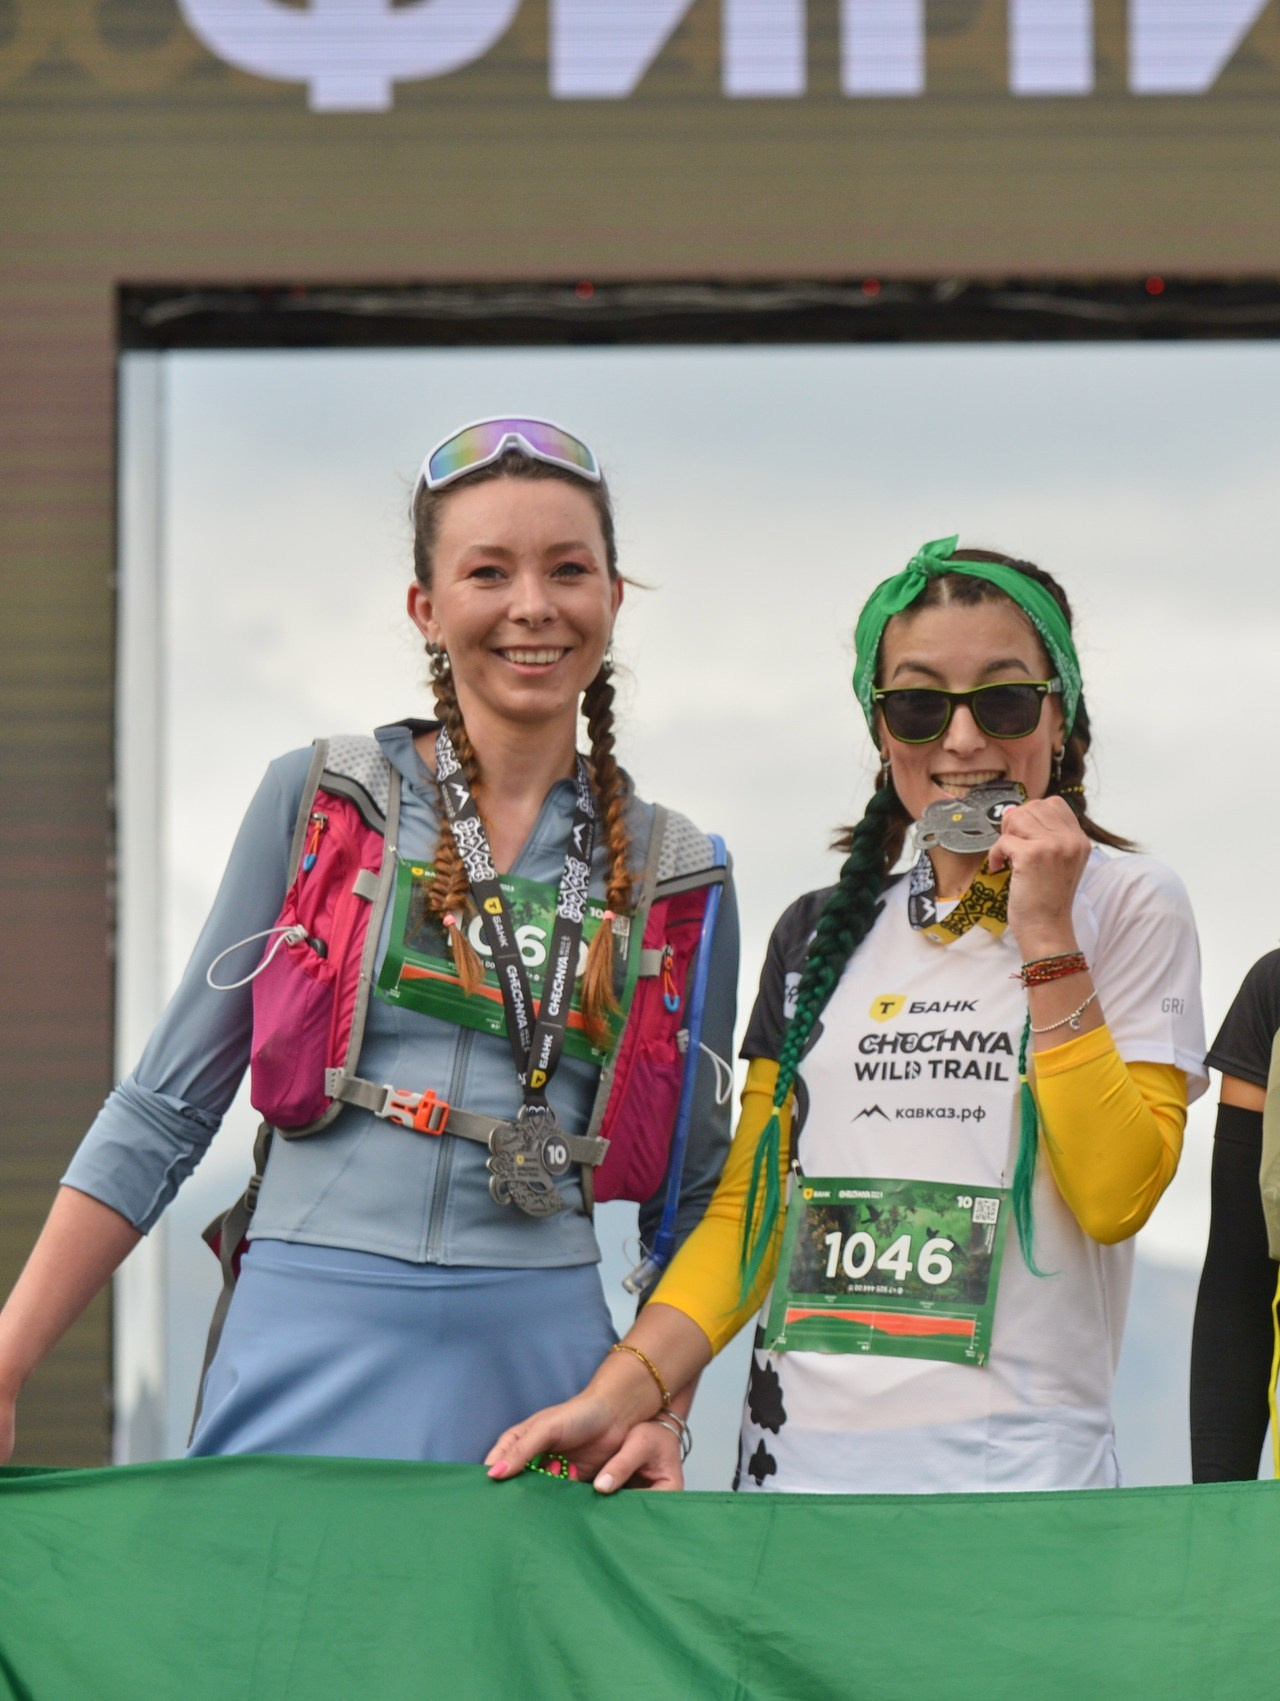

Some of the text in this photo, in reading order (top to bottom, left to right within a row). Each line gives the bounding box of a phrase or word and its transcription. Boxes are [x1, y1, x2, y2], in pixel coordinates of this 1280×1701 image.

[492, 916, 509, 948] БАНК
[908, 999, 980, 1014] БАНК
[538, 1034, 553, 1069] БАНК
[858, 1028, 1014, 1056] CHECHNYA
[854, 1058, 1009, 1082] WILD TRAIL
[895, 1104, 986, 1123] кавказ.рф
[547, 1144, 567, 1165] 10
[956, 1195, 973, 1209] 10
[824, 1230, 955, 1285] 1046
